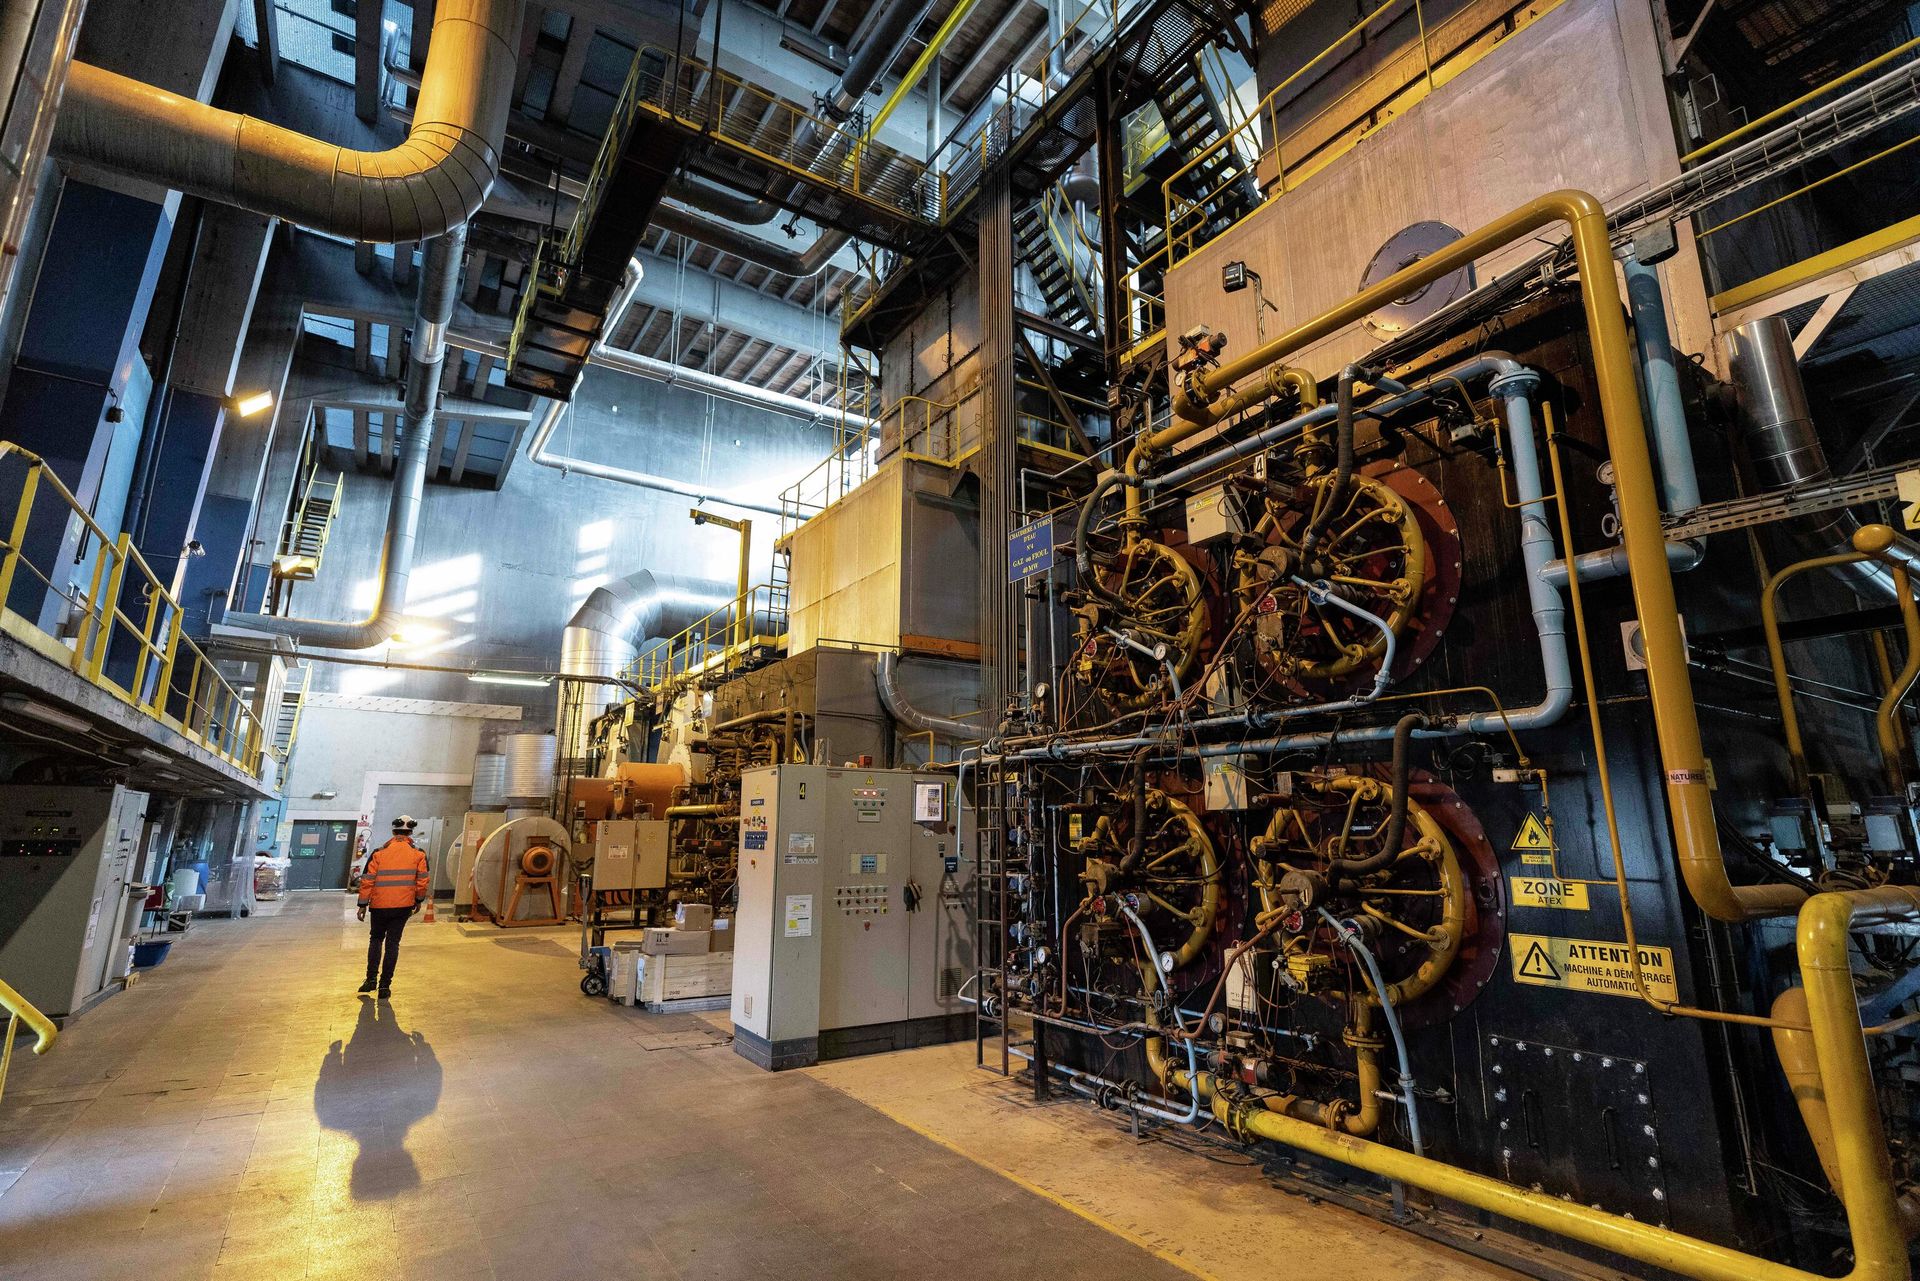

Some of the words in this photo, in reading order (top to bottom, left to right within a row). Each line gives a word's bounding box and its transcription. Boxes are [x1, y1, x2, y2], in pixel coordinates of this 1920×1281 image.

[1256, 457, 1264, 476] 4
[1013, 558, 1024, 567] GAZ
[1032, 548, 1048, 560] FIOUL
[800, 783, 806, 798] 4
[1523, 881, 1575, 897] ZONE
[1537, 896, 1562, 905] ATEX
[1569, 944, 1663, 967] ATTENTON
[1564, 963, 1603, 976] MACHINE
[1613, 967, 1672, 985] DÉMRRAGE
